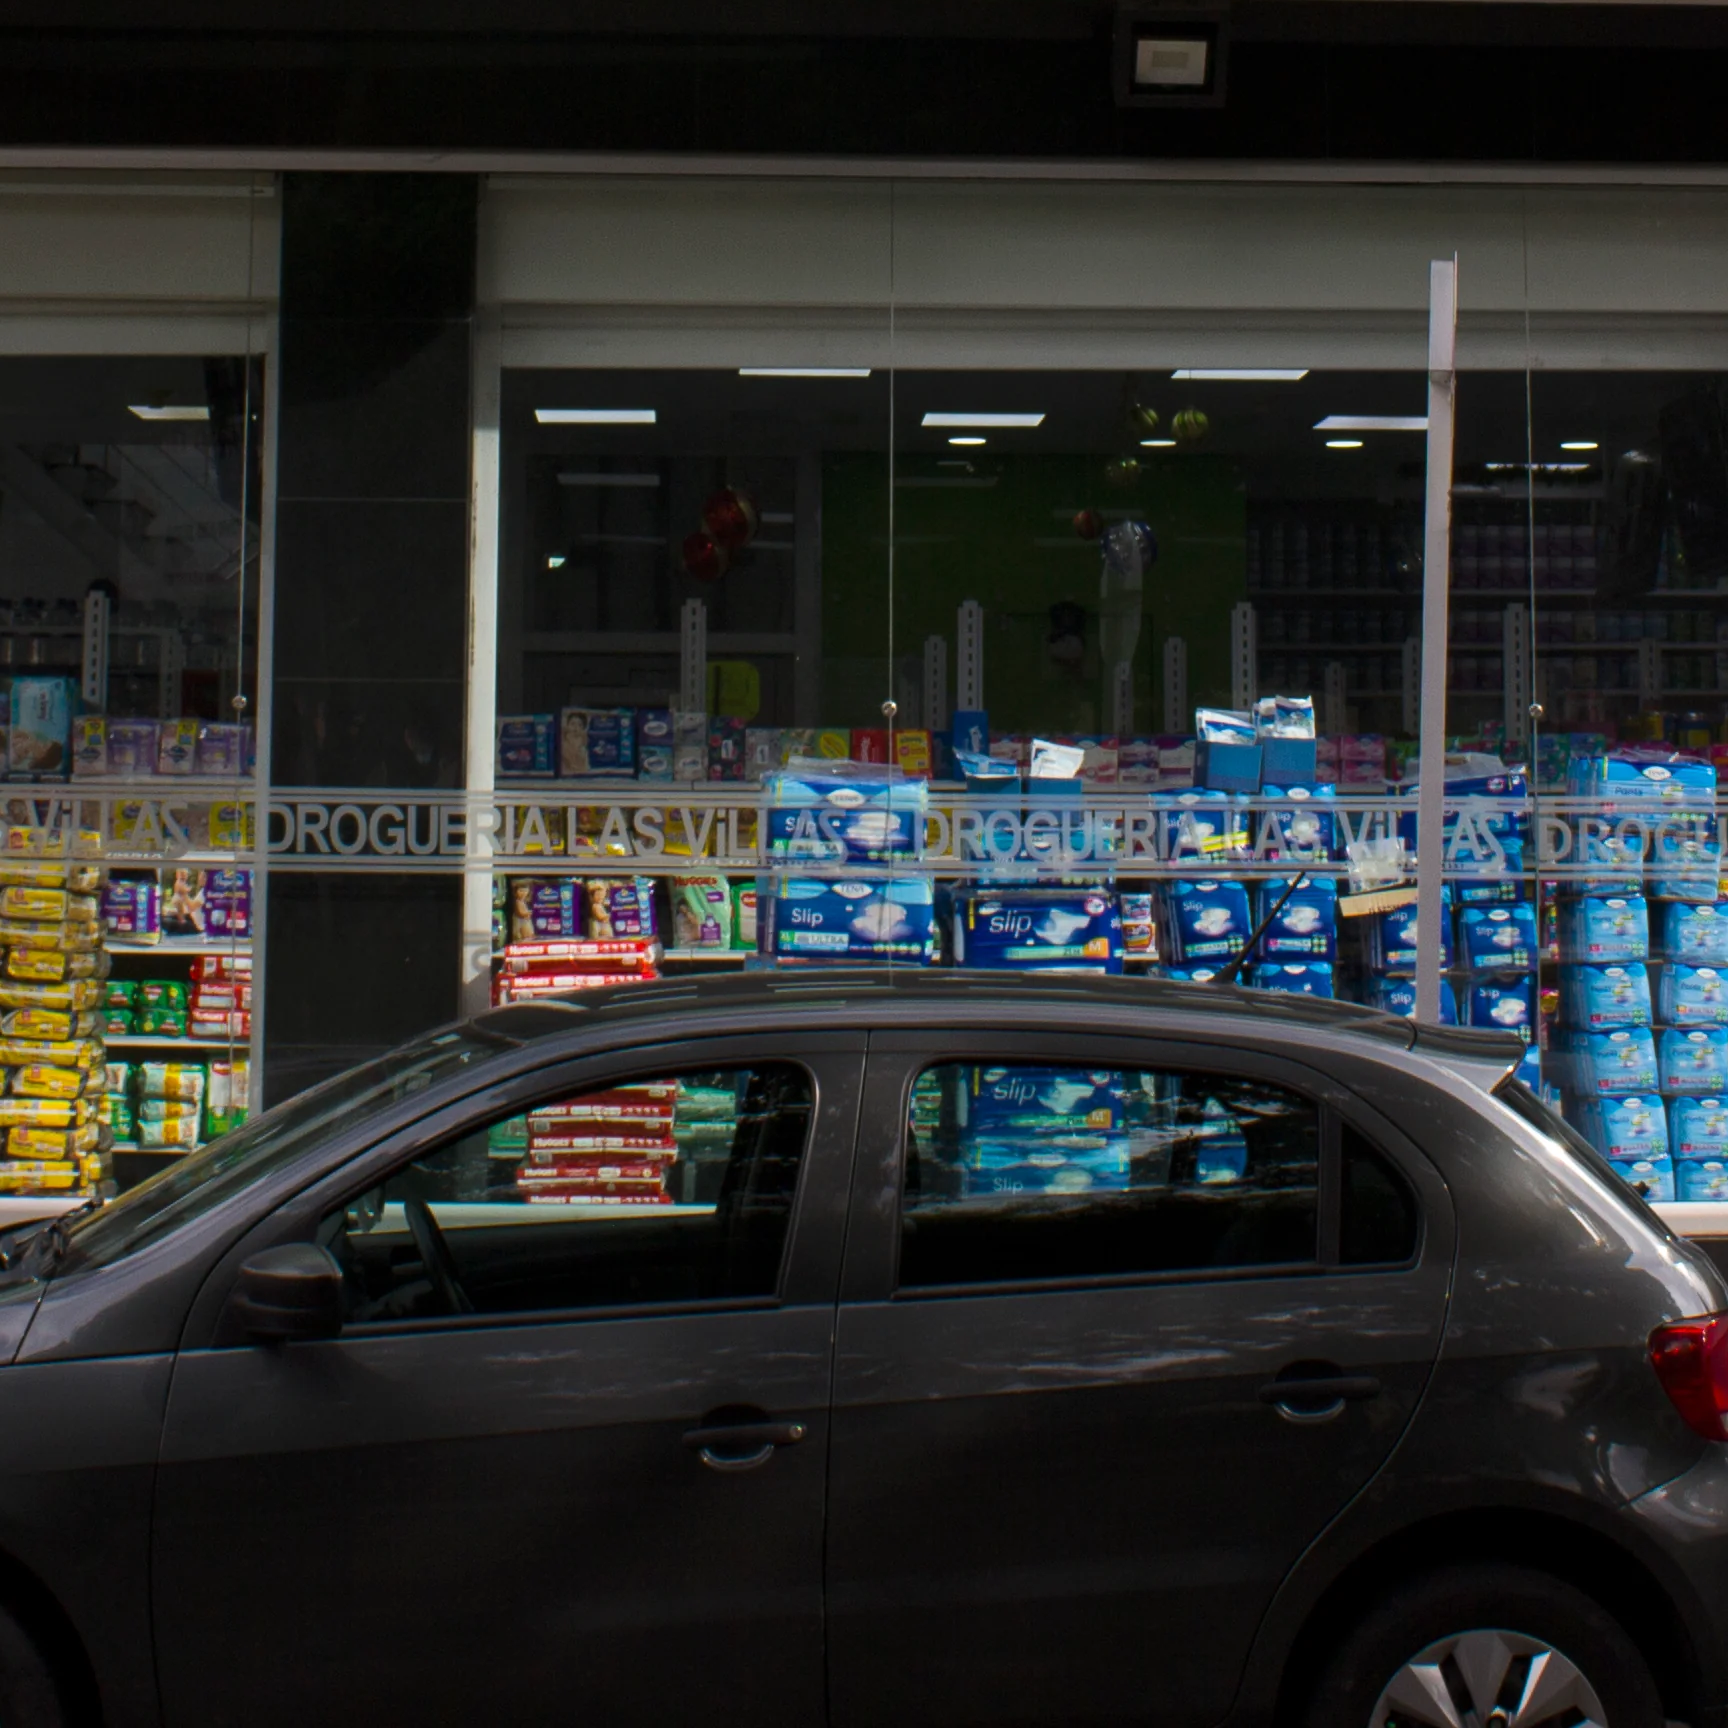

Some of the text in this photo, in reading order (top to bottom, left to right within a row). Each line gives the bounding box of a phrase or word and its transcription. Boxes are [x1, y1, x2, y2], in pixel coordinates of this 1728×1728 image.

[265, 802, 554, 856] DROGUERIA
[568, 805, 665, 856] LAS
[914, 808, 1204, 863] DROGUERIA
[791, 908, 824, 928] Slip
[988, 910, 1033, 934] slip
[992, 1077, 1036, 1106] slip
